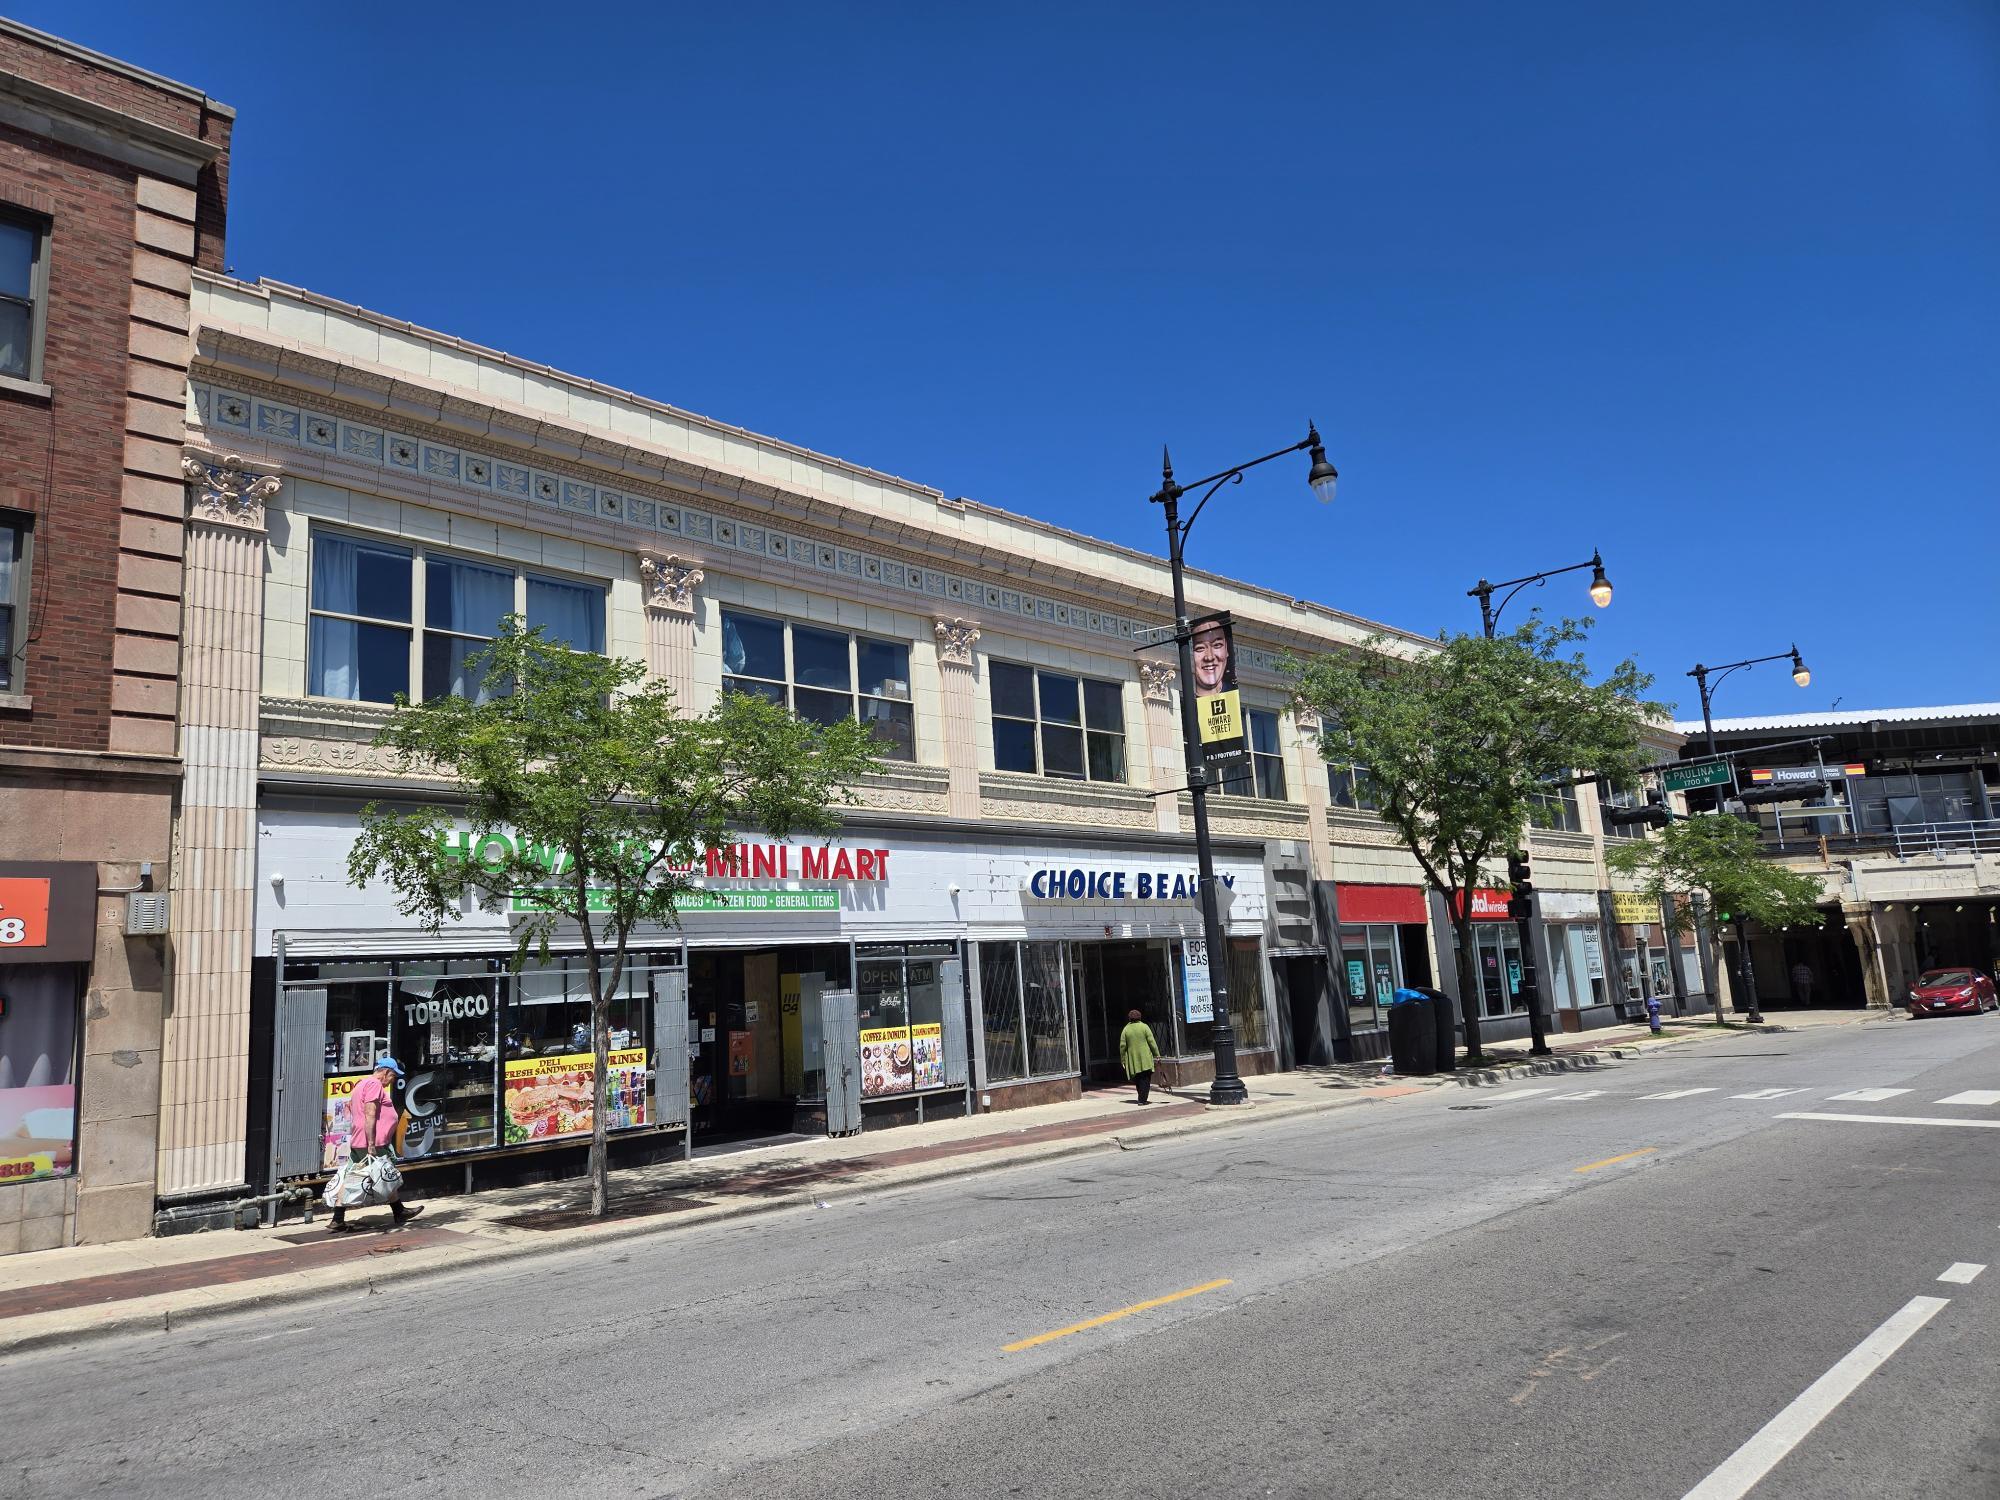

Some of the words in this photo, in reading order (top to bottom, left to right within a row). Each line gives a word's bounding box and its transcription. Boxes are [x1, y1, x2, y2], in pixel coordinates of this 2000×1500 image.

[1208, 715, 1231, 727] HOWARD
[1211, 723, 1231, 735] STREET
[1674, 768, 1715, 781] PAULINA
[1777, 769, 1817, 781] Howard
[1684, 778, 1701, 787] 1700
[1704, 776, 1711, 784] W
[705, 843, 787, 879] MINI
[801, 846, 890, 881] MART
[1030, 868, 1126, 899] CHOICE
[1137, 872, 1236, 899] BEAUY
[747, 895, 768, 907] FOOD
[775, 895, 810, 907] GENERAL
[812, 895, 835, 907] ITEMS
[1585, 934, 1598, 943] LEASE
[1189, 940, 1207, 952] FOR
[1185, 954, 1208, 966] LEAS
[862, 969, 898, 984] OPEN
[910, 967, 931, 981] ATM
[404, 993, 490, 1027] TOBACCO
[862, 1031, 882, 1043] COFFEE
[882, 1031, 887, 1040] &
[887, 1029, 907, 1041] DONUTS
[539, 1058, 561, 1067] DELI
[609, 1052, 644, 1066] RINKS
[505, 1069, 533, 1079] FRESH
[534, 1062, 594, 1076] SANDWICHES
